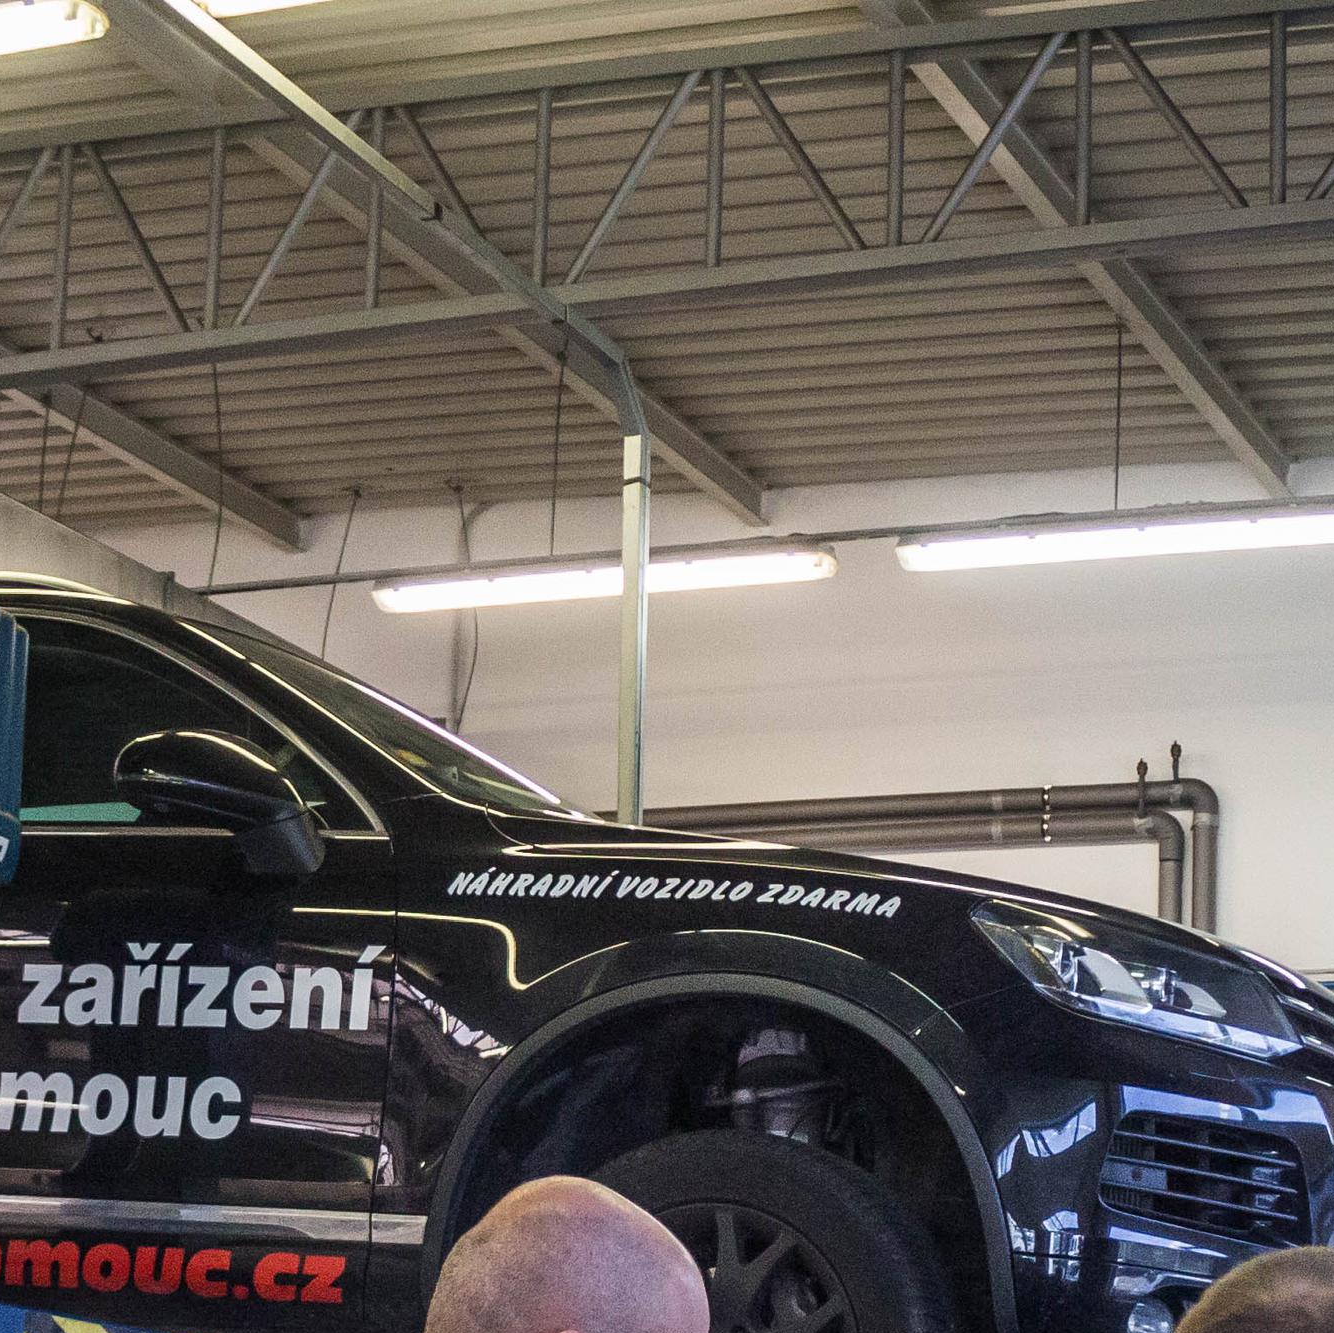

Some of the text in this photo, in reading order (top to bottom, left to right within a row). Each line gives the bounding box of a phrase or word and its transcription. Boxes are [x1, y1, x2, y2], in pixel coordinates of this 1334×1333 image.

[447, 866, 902, 918] NÁHRADNÍ VOZIDLO ZDARMA
[17, 941, 387, 1032] zařízení
